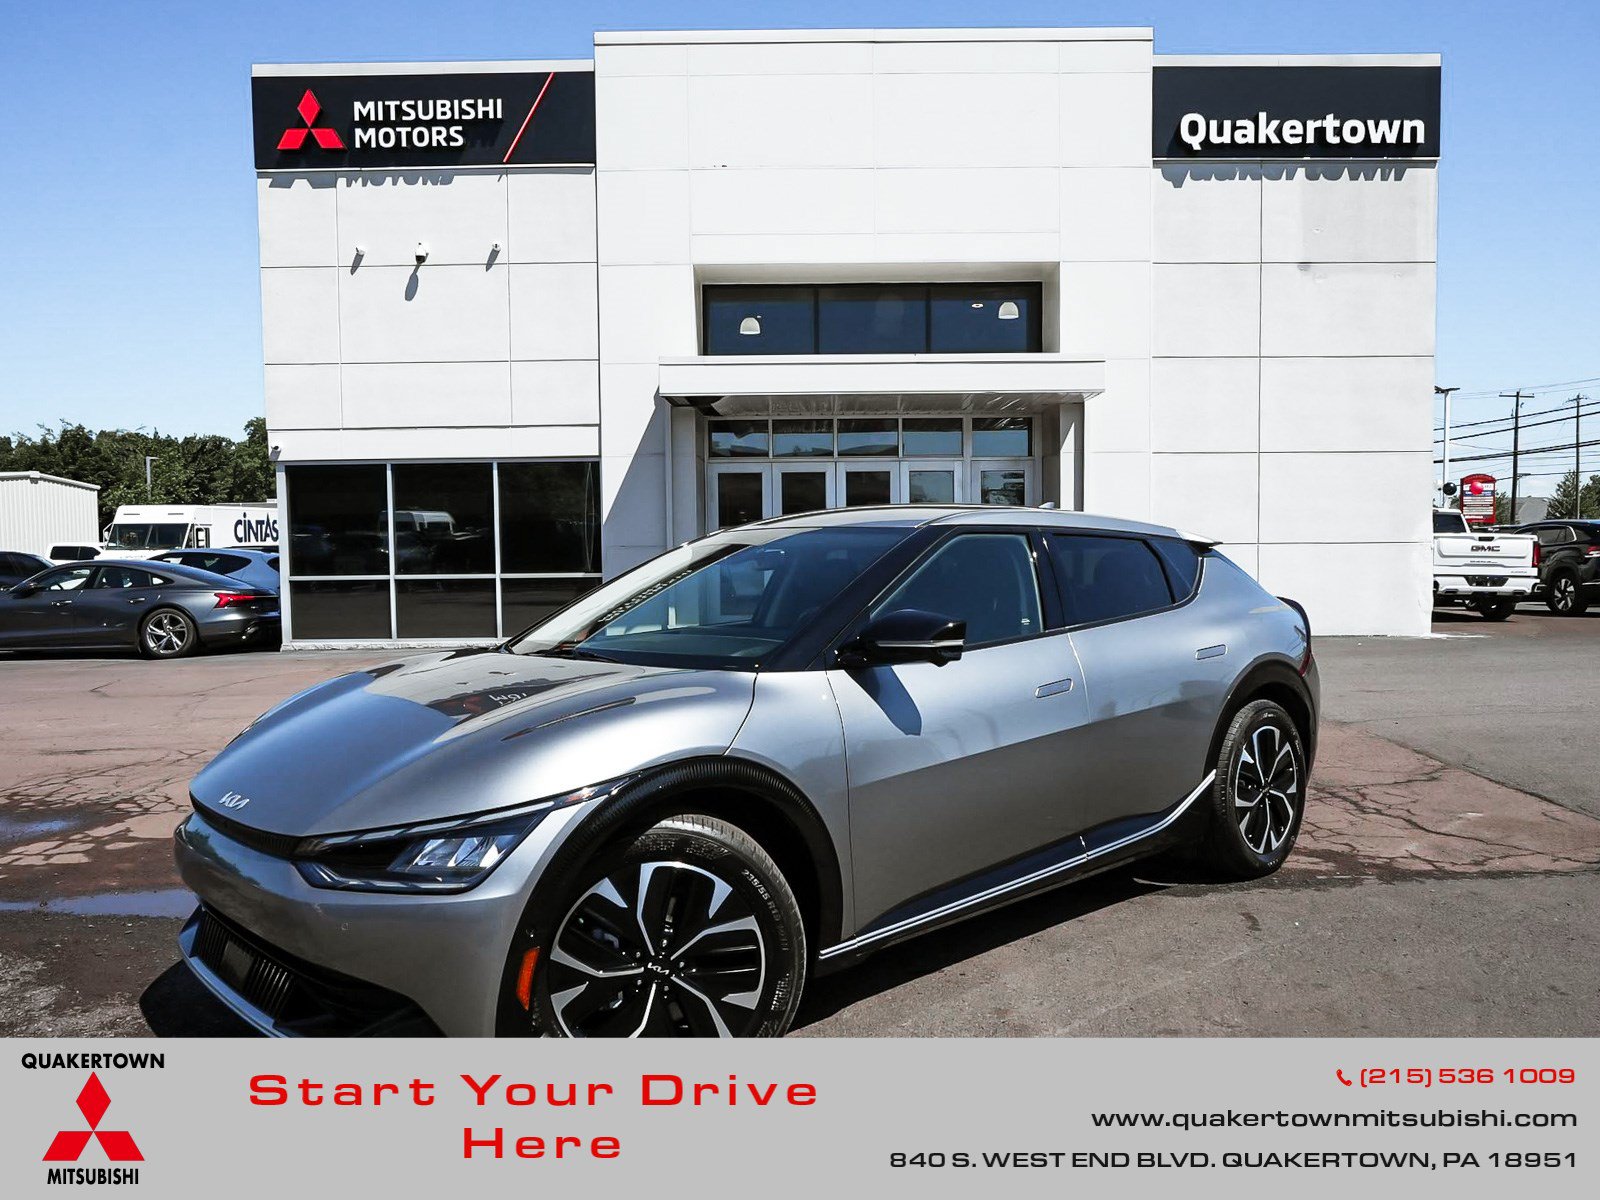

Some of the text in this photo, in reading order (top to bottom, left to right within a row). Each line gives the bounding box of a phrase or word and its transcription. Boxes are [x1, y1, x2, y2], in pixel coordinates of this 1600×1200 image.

[352, 98, 503, 121] MITSUBISHI
[353, 125, 464, 149] MOTORS
[1179, 111, 1426, 151] Quakertown
